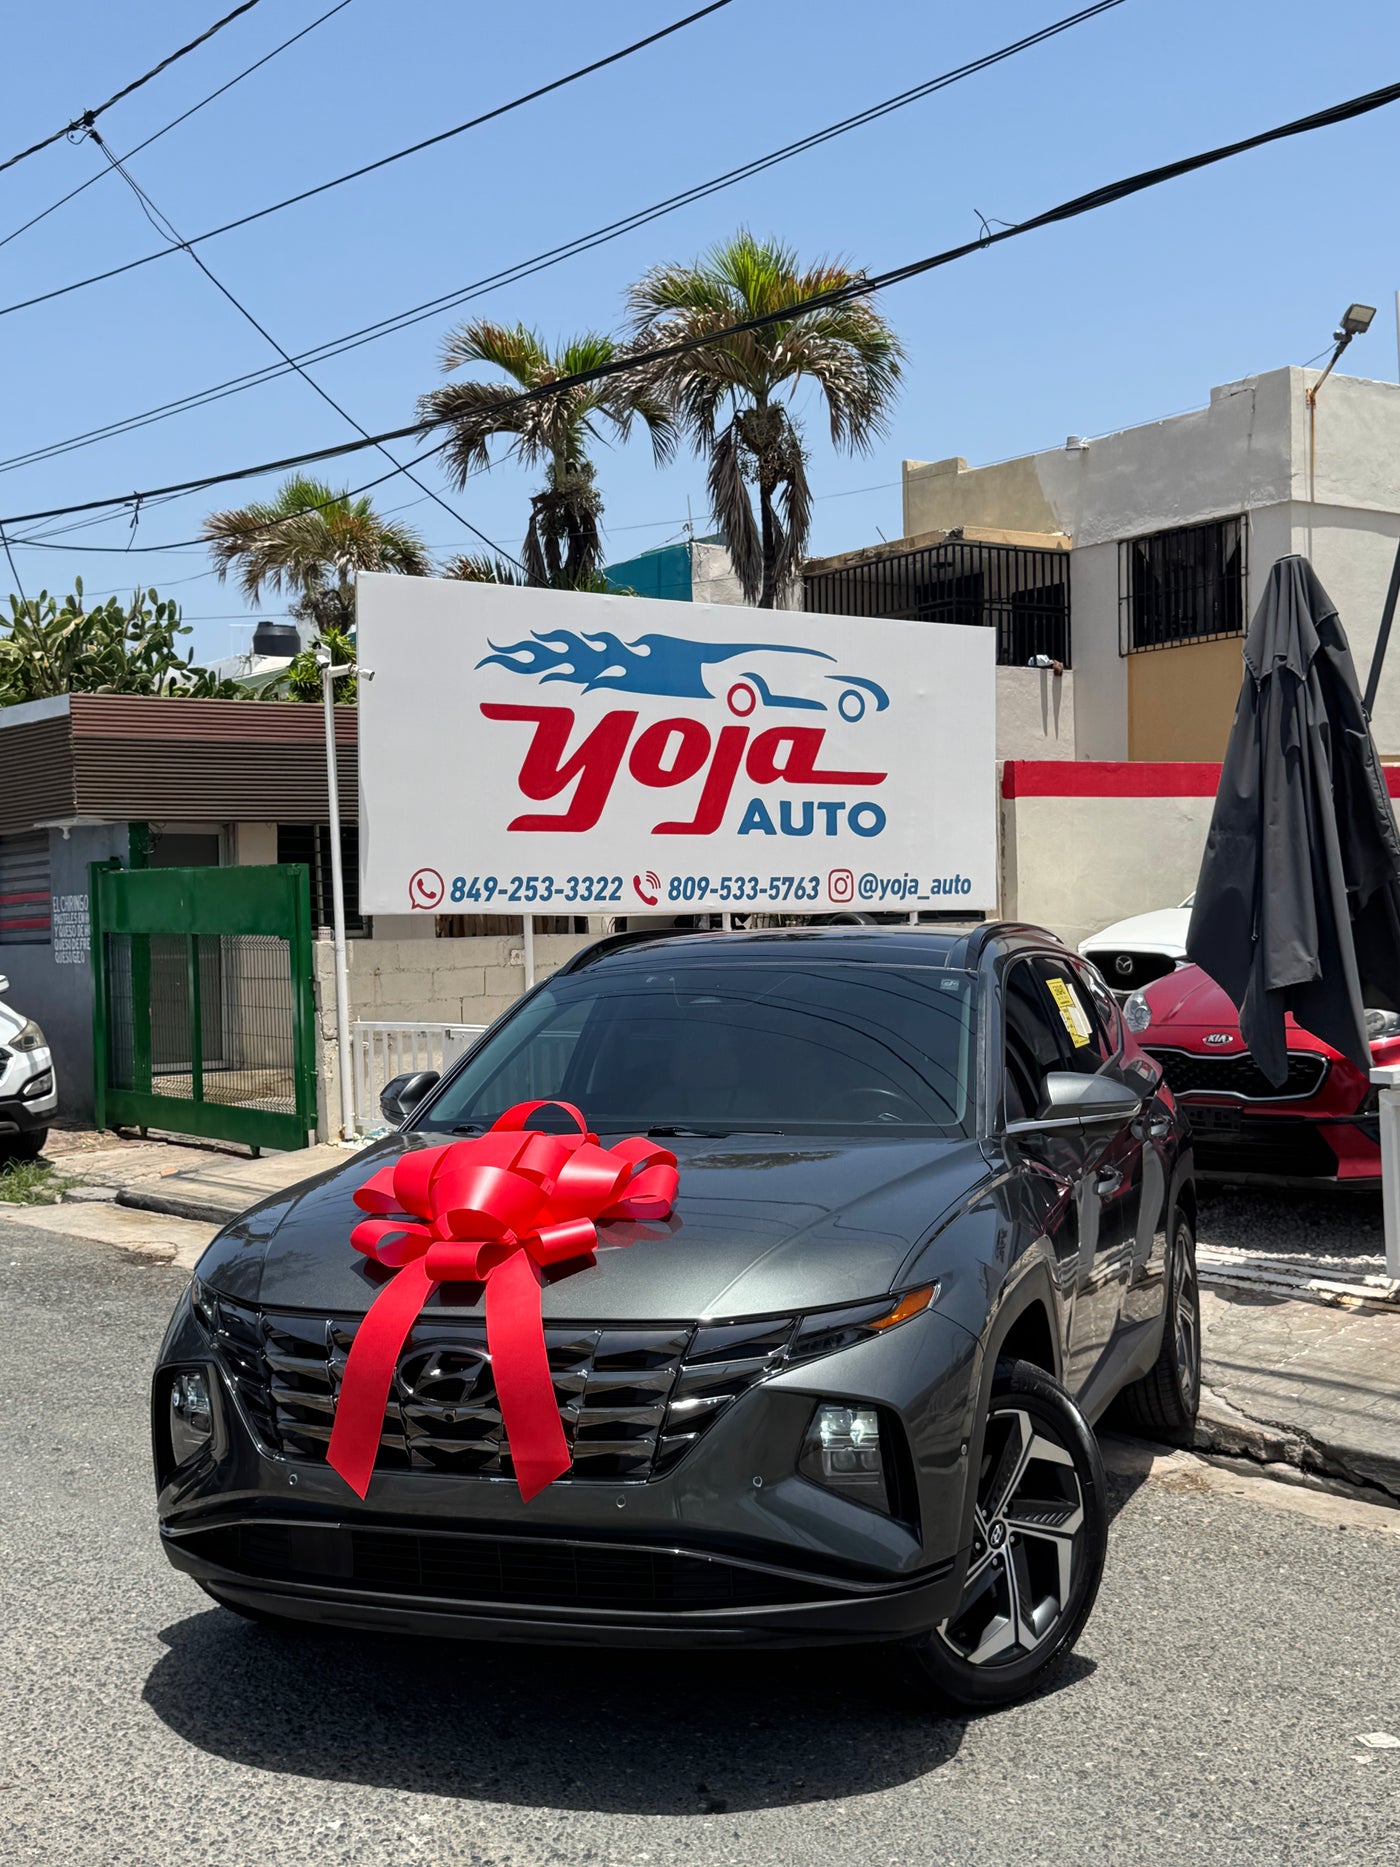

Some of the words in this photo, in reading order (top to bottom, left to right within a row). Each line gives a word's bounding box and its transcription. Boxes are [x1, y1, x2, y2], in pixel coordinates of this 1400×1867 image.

[738, 798, 887, 838] AUTO
[450, 876, 624, 903] 849-253-3322
[668, 876, 821, 901] 809-533-5763
[858, 872, 972, 901] @yoja_auto
